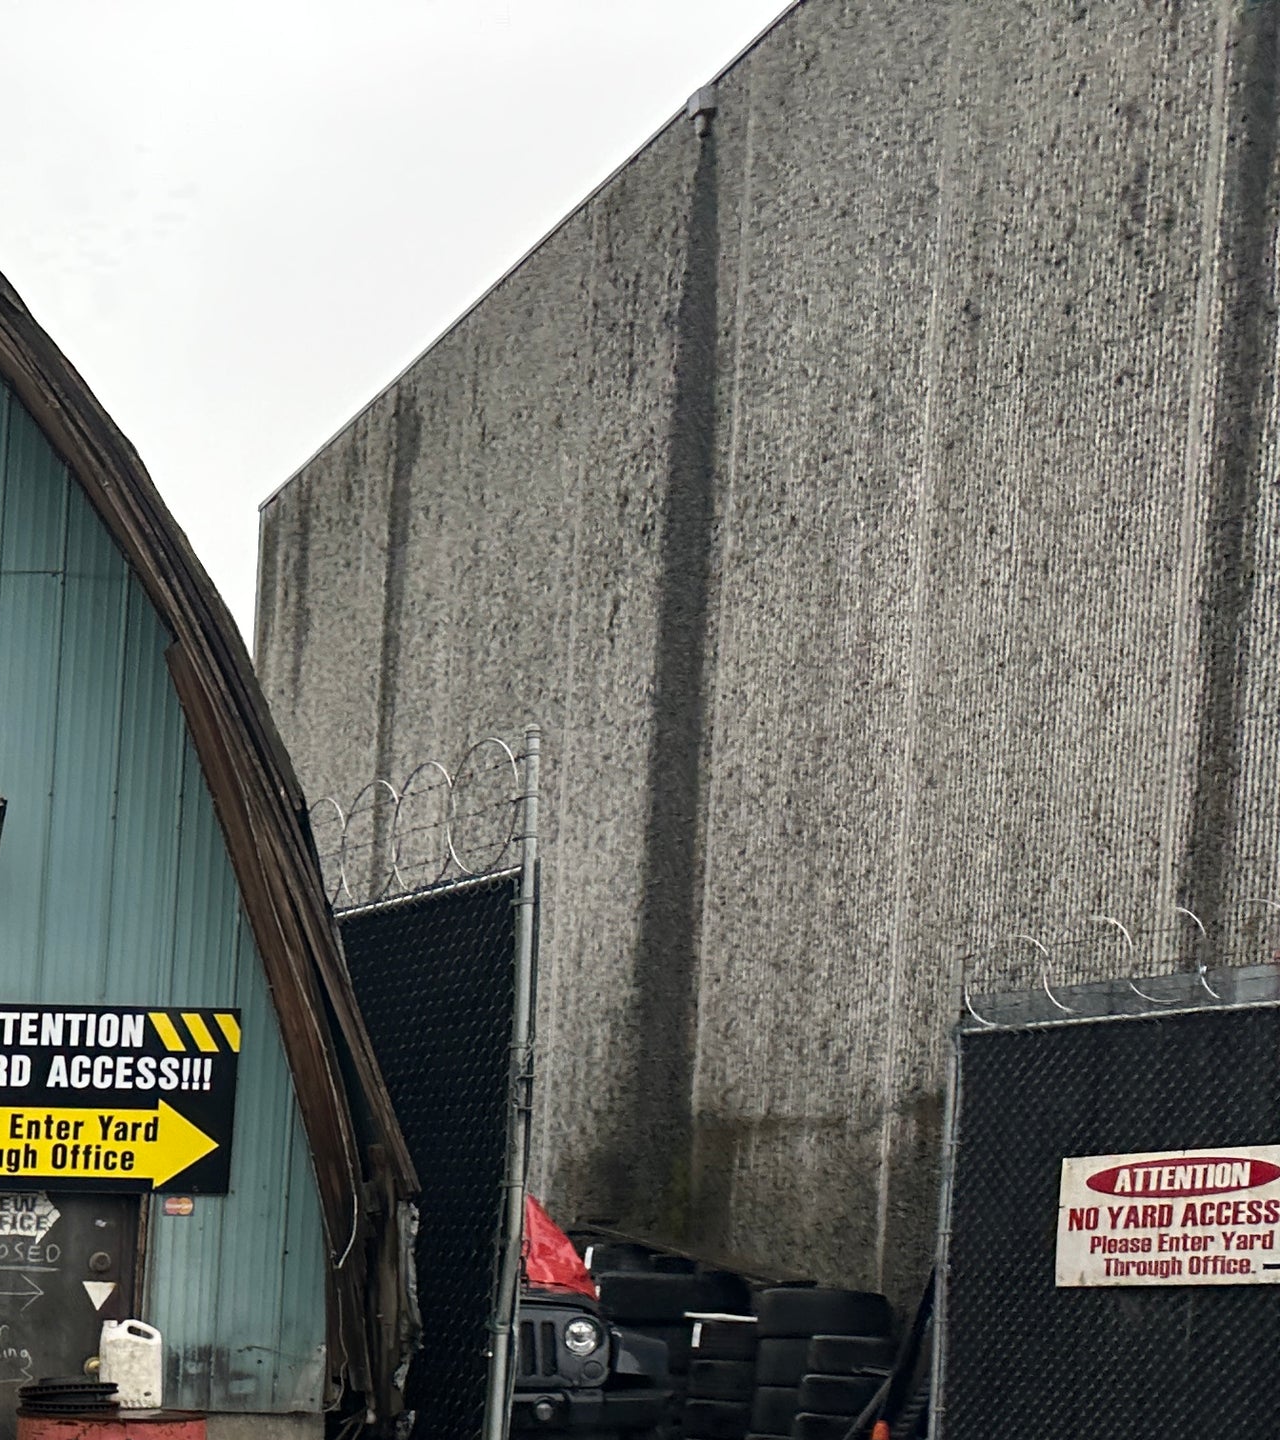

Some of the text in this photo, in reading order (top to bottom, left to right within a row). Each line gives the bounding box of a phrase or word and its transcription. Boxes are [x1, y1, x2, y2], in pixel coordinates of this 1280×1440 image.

[45, 1055, 214, 1091] ACCESS!!!
[9, 1113, 85, 1140] Enter
[98, 1115, 160, 1142] Yard
[51, 1144, 135, 1171] Office
[1113, 1161, 1252, 1193] ATTENTION
[1068, 1199, 1280, 1231] NO YARD ACCESS
[1090, 1230, 1275, 1254] Please Enter Yard
[1104, 1255, 1257, 1279] Through Office.
